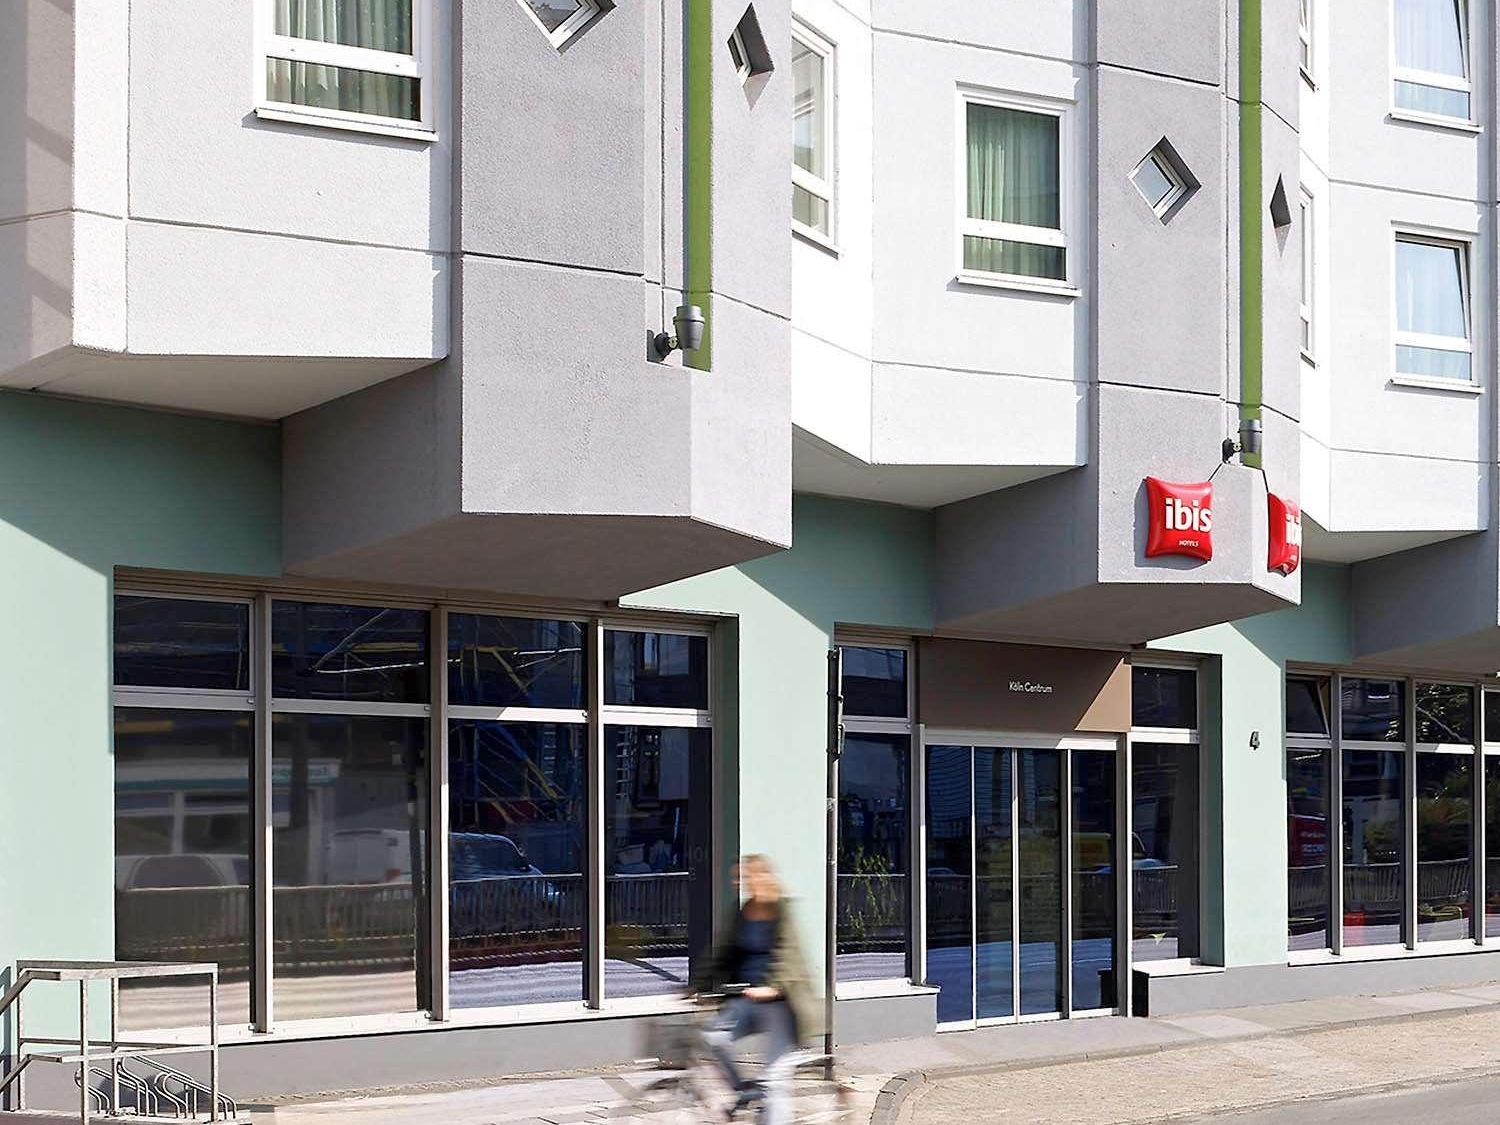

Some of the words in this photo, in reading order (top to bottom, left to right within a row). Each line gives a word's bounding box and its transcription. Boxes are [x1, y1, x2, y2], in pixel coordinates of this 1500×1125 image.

[1165, 497, 1213, 533] ibis
[1009, 681, 1024, 691] Köln
[1024, 681, 1053, 693] Centrum
